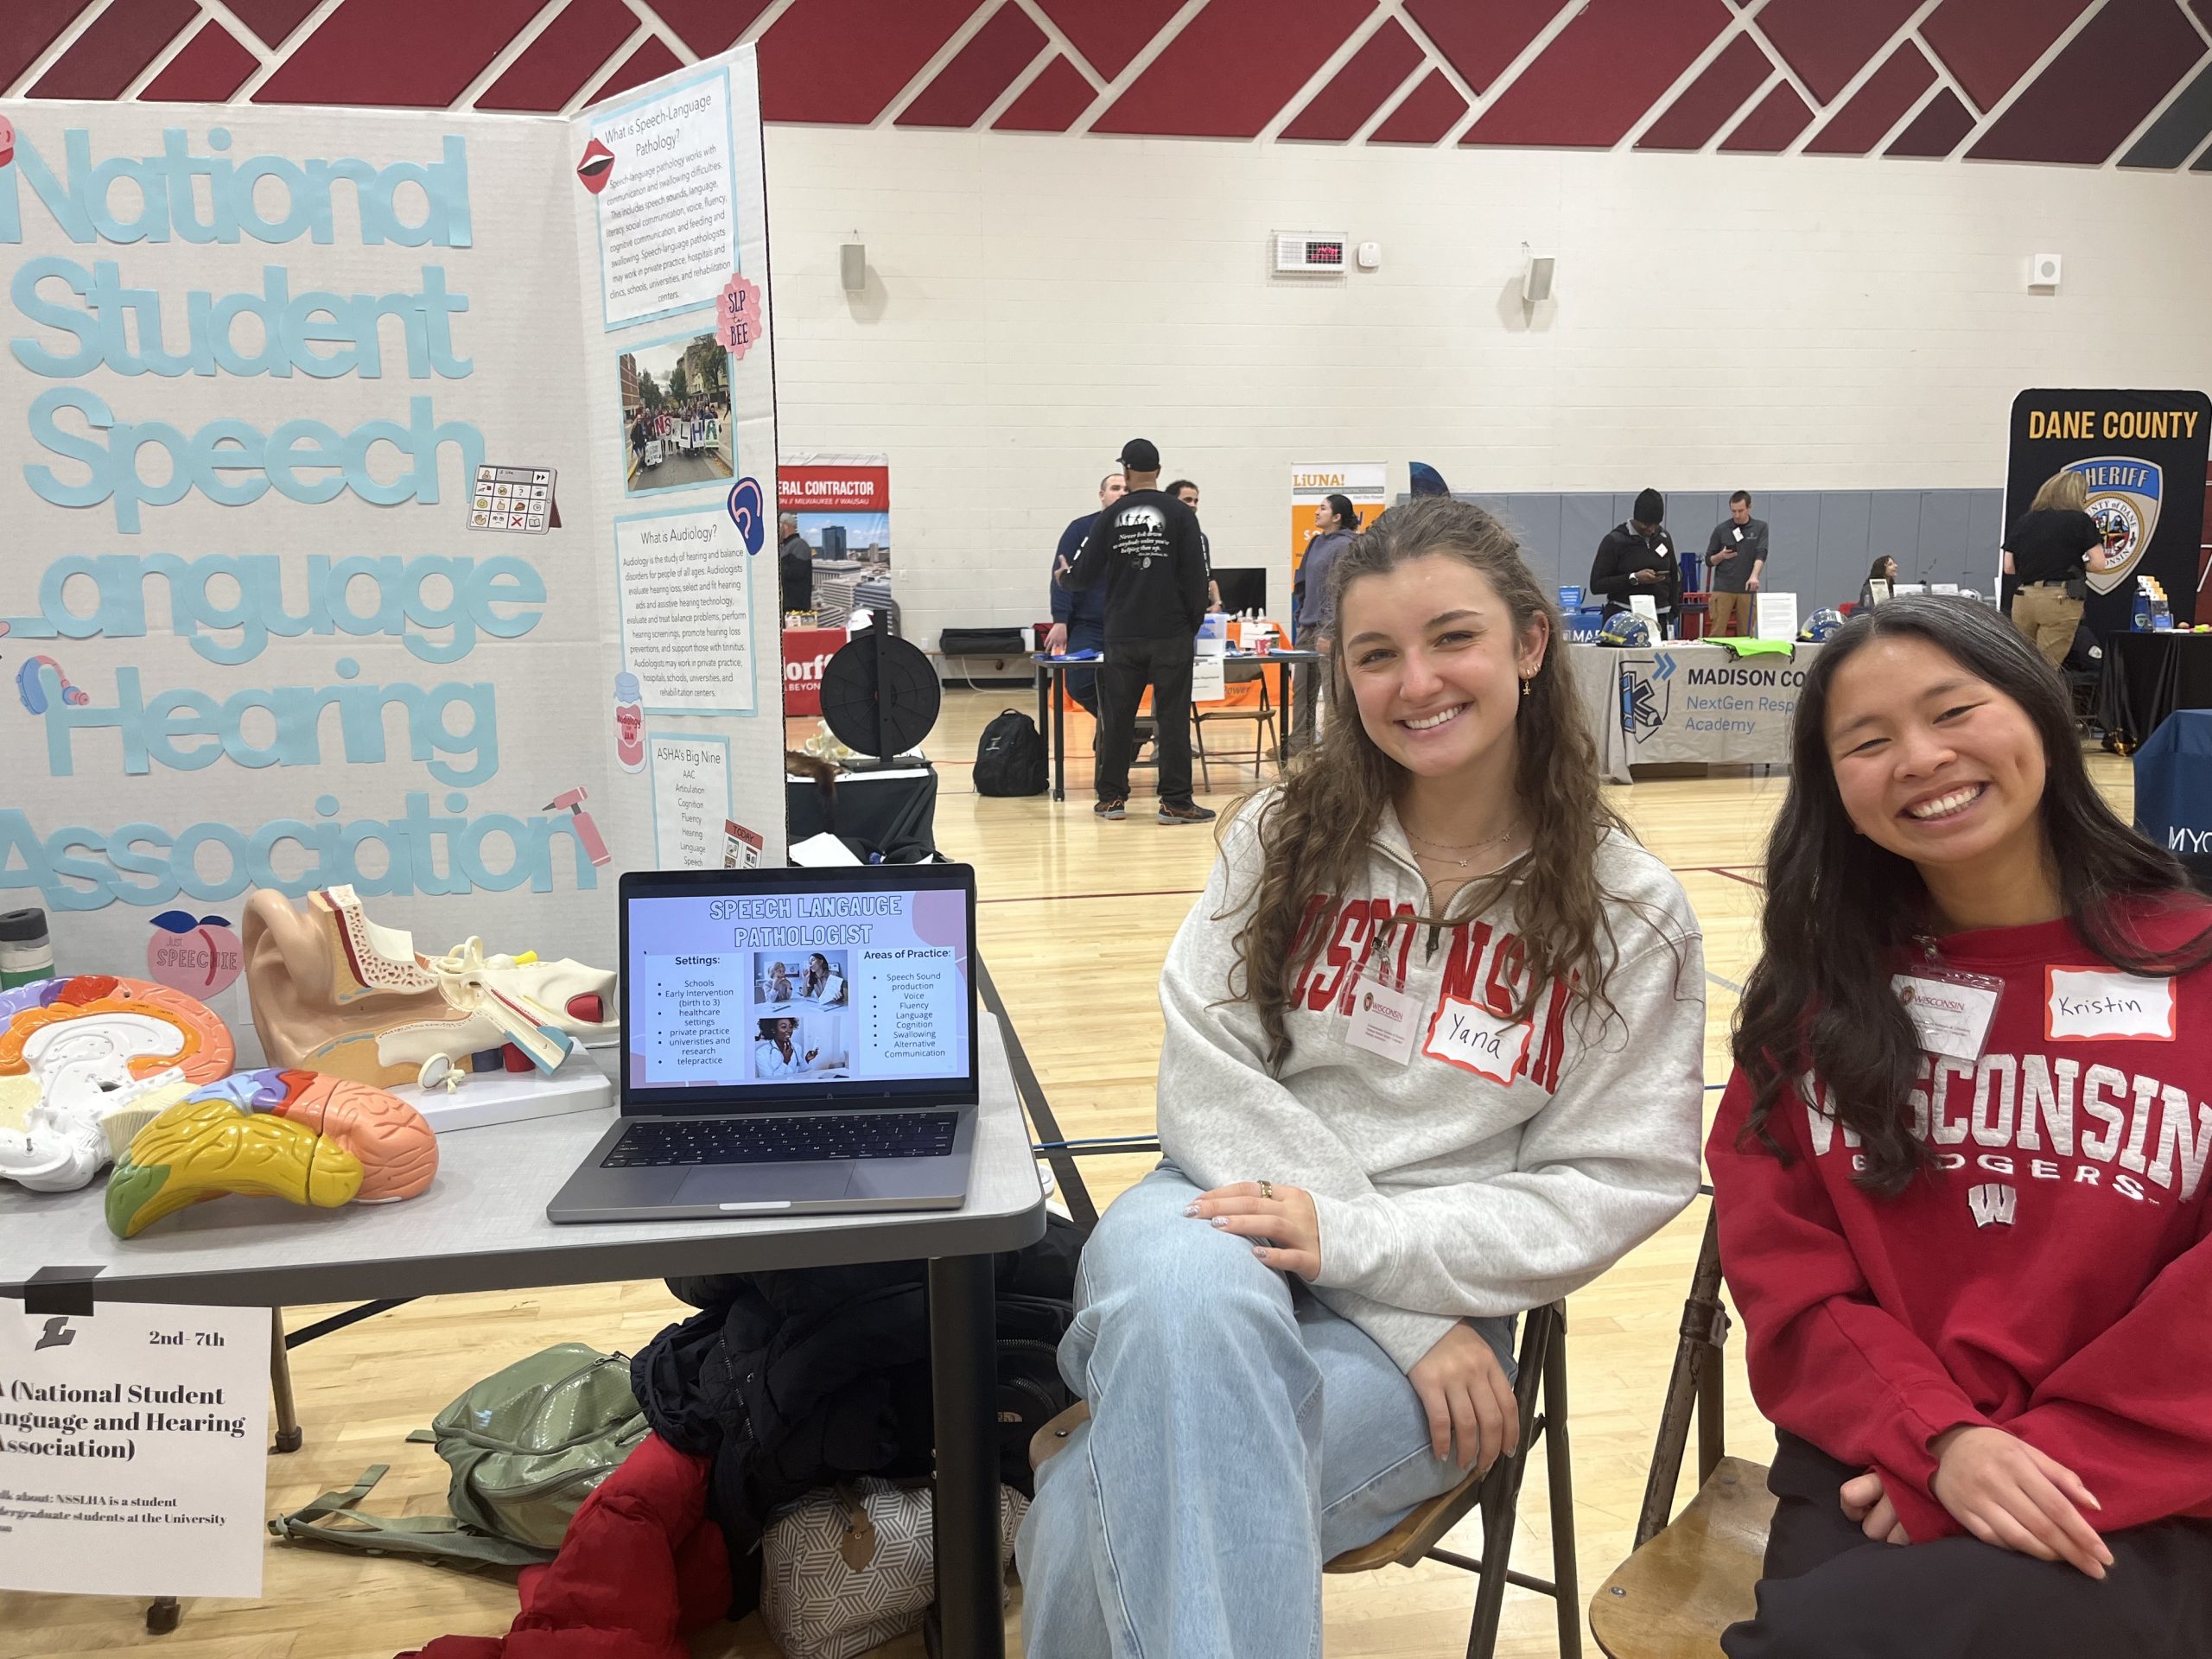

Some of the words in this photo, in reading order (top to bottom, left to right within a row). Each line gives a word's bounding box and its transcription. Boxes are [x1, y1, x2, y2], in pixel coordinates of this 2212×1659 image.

[606, 127, 626, 143] What
[628, 124, 633, 135] is
[636, 95, 711, 135] Speech-Language
[636, 129, 679, 156] Pathology?
[0, 127, 473, 247] National
[690, 229, 725, 248] pathologists
[682, 270, 692, 281] and
[694, 261, 730, 276] rehabilitation
[728, 290, 745, 313] SLP
[10, 255, 474, 379] Student
[734, 314, 742, 323] to
[730, 323, 748, 346] BEE
[2030, 411, 2094, 439] DANE
[2103, 411, 2198, 439] COUNTY
[23, 386, 485, 534] Speech
[1293, 474, 1345, 486] LiUNA!
[2075, 467, 2149, 487] HERIFF
[805, 481, 874, 495] CONTRACTOR
[2088, 501, 2109, 514] NTY
[2120, 505, 2136, 527] DANE
[641, 532, 661, 544] What
[663, 531, 668, 542] is
[671, 524, 716, 542] Audiology?
[623, 557, 648, 567] Audiology
[654, 555, 663, 563] the
[664, 553, 678, 564] study
[679, 553, 684, 562] of
[686, 551, 707, 562] hearing
[709, 550, 719, 559] and
[721, 549, 743, 557] balance
[626, 572, 648, 581] disorders
[658, 569, 676, 580] people
[677, 569, 682, 577] of
[707, 565, 742, 575] Audiologists
[632, 631, 651, 640] hearing
[652, 630, 680, 639] screenings,
[682, 629, 705, 639] promote
[707, 627, 728, 638] hearing
[729, 626, 741, 636] loss
[1573, 630, 1600, 642] MA
[1688, 669, 1776, 686] MADISON
[1688, 696, 1753, 710] NextGen
[38, 658, 499, 788] Hearing
[1686, 717, 1755, 734] Academy
[658, 747, 684, 760] ASHA's
[686, 749, 699, 766] Big
[702, 751, 721, 764] Nine
[683, 770, 695, 779] AAC
[676, 784, 704, 794] Articulation
[678, 798, 703, 810] Cognition
[682, 813, 702, 825] Fluency
[683, 828, 702, 840] Hearing
[734, 825, 753, 842] TODAY
[0, 792, 598, 913] Association
[680, 842, 705, 853] Language
[684, 856, 702, 867] Speech
[709, 899, 791, 920] SPEECH
[798, 896, 902, 918] LANGAUGE
[734, 925, 873, 947] PATHOLOGIST
[676, 957, 720, 966] Settings:
[864, 950, 892, 959] Areas
[895, 950, 905, 958] of
[907, 949, 950, 958] Practice:
[887, 973, 914, 982] Speech
[893, 982, 933, 992] production
[679, 999, 700, 1007] (birth
[1372, 1002, 1403, 1020] WISCONSIN
[1914, 995, 1964, 1010] WISCONSIN
[2059, 996, 2143, 1016] Kristin
[897, 1021, 932, 1030] Cognition
[1449, 1013, 1502, 1060] Yana
[677, 1057, 722, 1066] telepractice
[195, 1332, 225, 1347] 7th
[12, 1379, 122, 1403] (National
[128, 1384, 226, 1405] Student
[93, 1412, 140, 1431] and
[146, 1413, 246, 1438] Hearing
[16, 1491, 54, 1503] about:
[57, 1494, 106, 1505] NSSLHA
[110, 1497, 118, 1506] is
[121, 1497, 128, 1506] a
[131, 1497, 177, 1507] student
[73, 1511, 124, 1522] students
[143, 1513, 162, 1523] the
[165, 1514, 226, 1526] University
